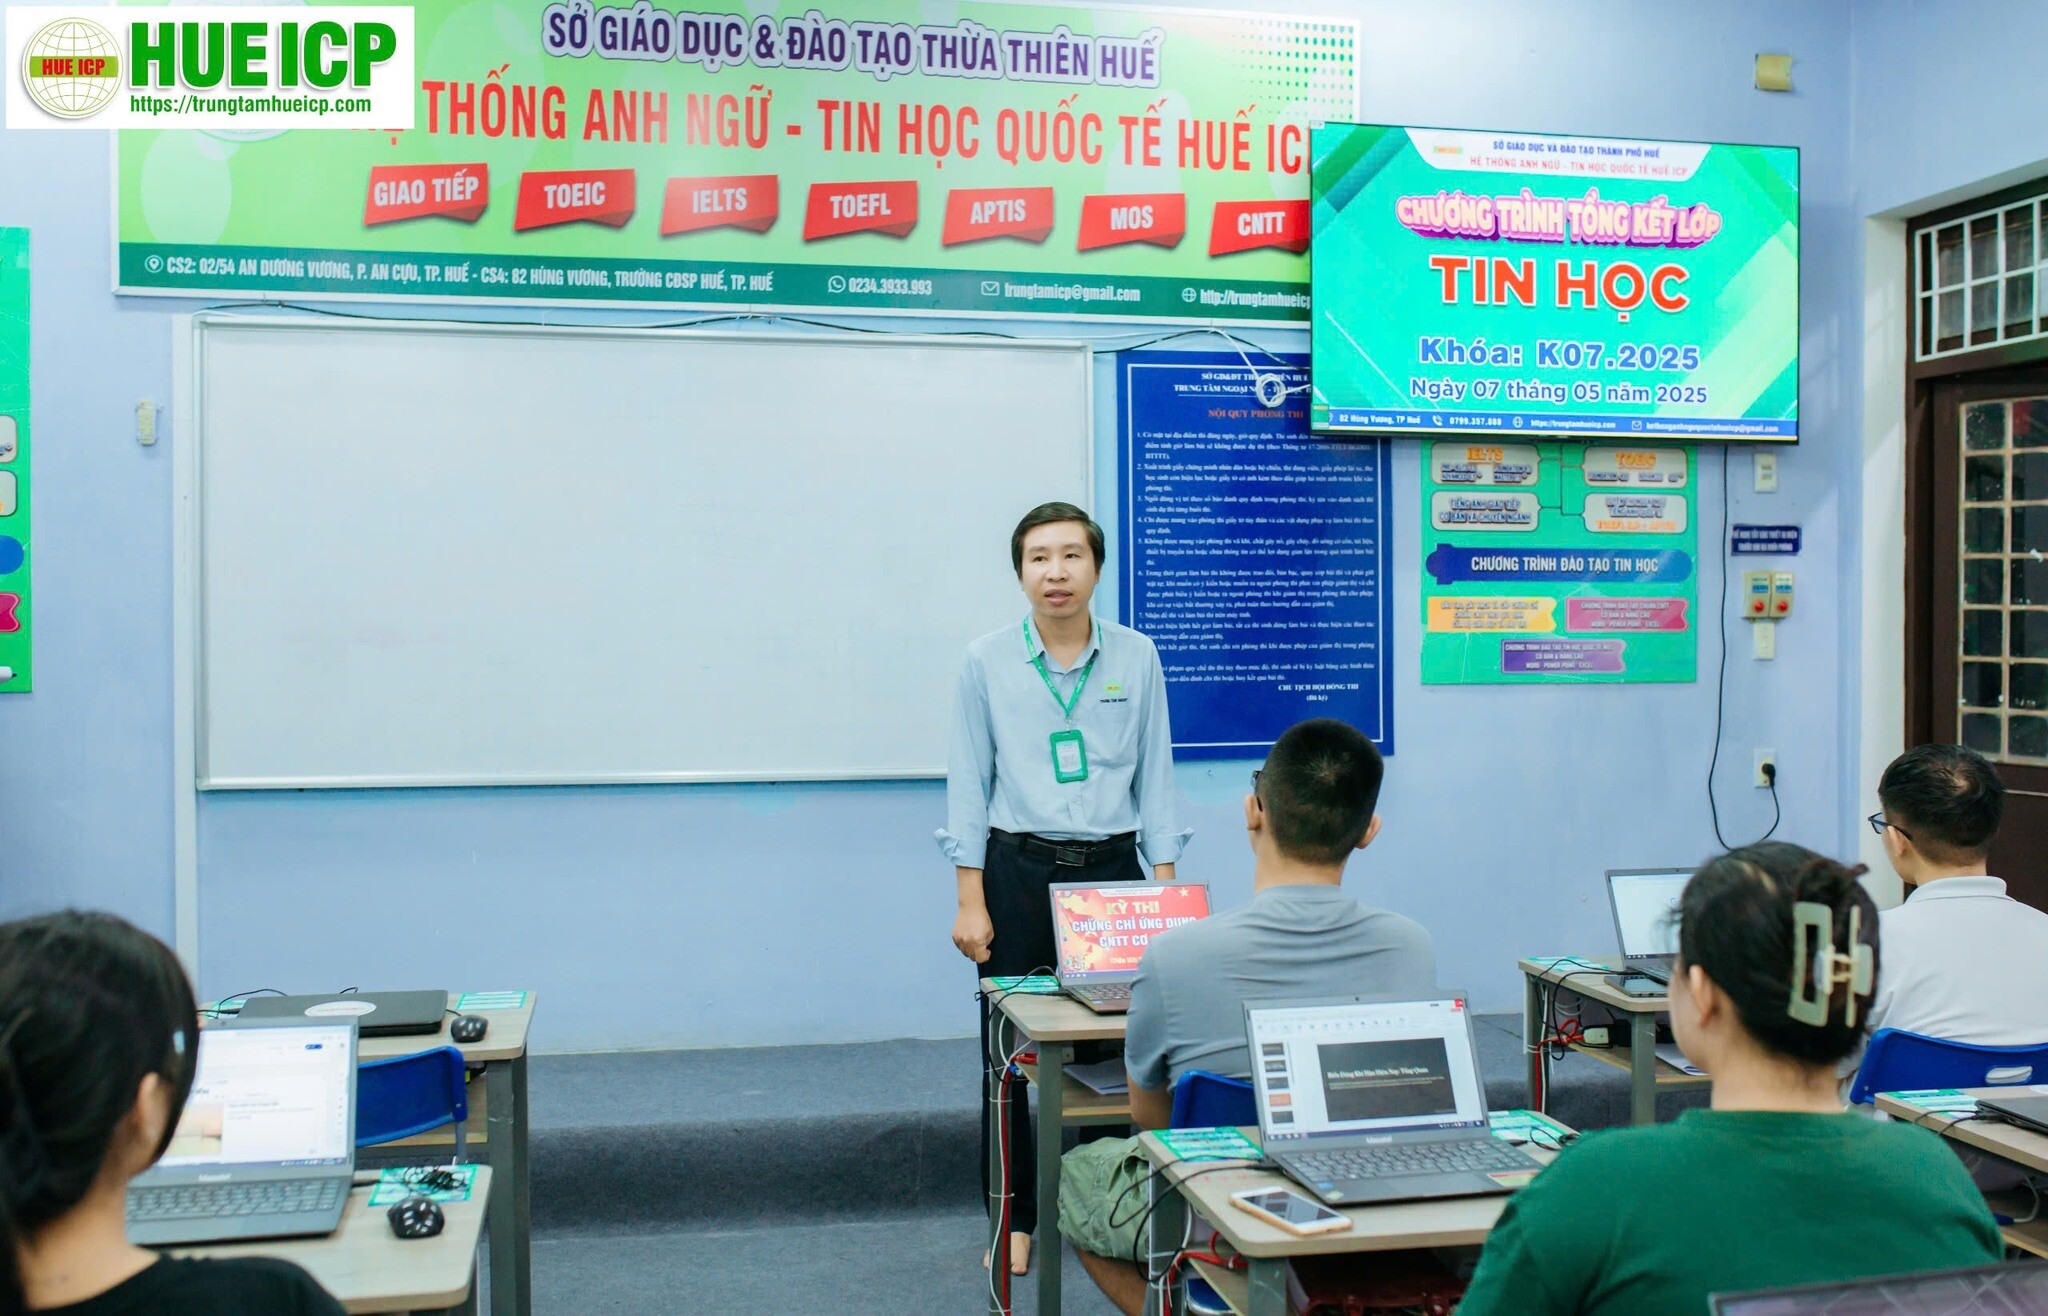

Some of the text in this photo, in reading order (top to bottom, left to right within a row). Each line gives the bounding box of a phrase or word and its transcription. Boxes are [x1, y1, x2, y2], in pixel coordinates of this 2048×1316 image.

[549, 3, 1159, 80] SỞ GIÁO DỤC & ĐÀO TẠO THỪA THIÊN HUẾ
[422, 64, 1311, 175] THỐNG ANH NGỮ - TIN HỌC QUỐC TẾ HUẾ IC
[374, 169, 479, 207] GIAO TIẾP
[544, 181, 606, 209] TOEIC
[692, 187, 747, 213] IELTS
[830, 193, 891, 218] TOEFL
[970, 199, 1026, 224] APTIS
[1111, 205, 1153, 230] MOS
[1398, 188, 1721, 240] CHƯƠNG TRÌNH TỔNG KẾT LỚP
[1238, 211, 1286, 236] CNTT
[167, 256, 196, 274] CS2:
[200, 258, 235, 275] 02/54
[239, 259, 257, 276] AN
[260, 258, 304, 278] DƯƠNG
[307, 260, 353, 281] VƯƠNG,
[357, 263, 368, 280] P.
[371, 263, 389, 281] AN
[392, 263, 421, 284] CỰU,
[424, 265, 441, 282] TP.
[444, 261, 470, 282] HUẾ
[480, 266, 509, 283] CS4:
[512, 267, 527, 284] 82
[530, 265, 563, 285] HÙNG
[567, 268, 611, 288] VƯƠNG,
[614, 268, 662, 288] TRƯỜNG
[700, 269, 728, 292] HUẾ,
[731, 274, 747, 291] TP.
[750, 271, 774, 292] HUẾ
[848, 277, 932, 296] 0234.3933.993
[1004, 282, 1141, 303] trungtamicp@gmail.com
[1431, 257, 1689, 320] TIN HỌC
[1421, 338, 1699, 370] Khóa: K07.2025
[1412, 379, 1707, 403] Ngày 07 tháng 05 năm 2025
[1471, 555, 1659, 576] CHƯƠNG TRÌNH ĐÀO TẠO TIN HỌC
[1105, 899, 1160, 915] KỲ THI
[1072, 917, 1113, 932] CHỨNG
[1116, 917, 1136, 930] CHỈ
[1139, 916, 1163, 929] ỨNG
[1132, 935, 1148, 946] CƠ
